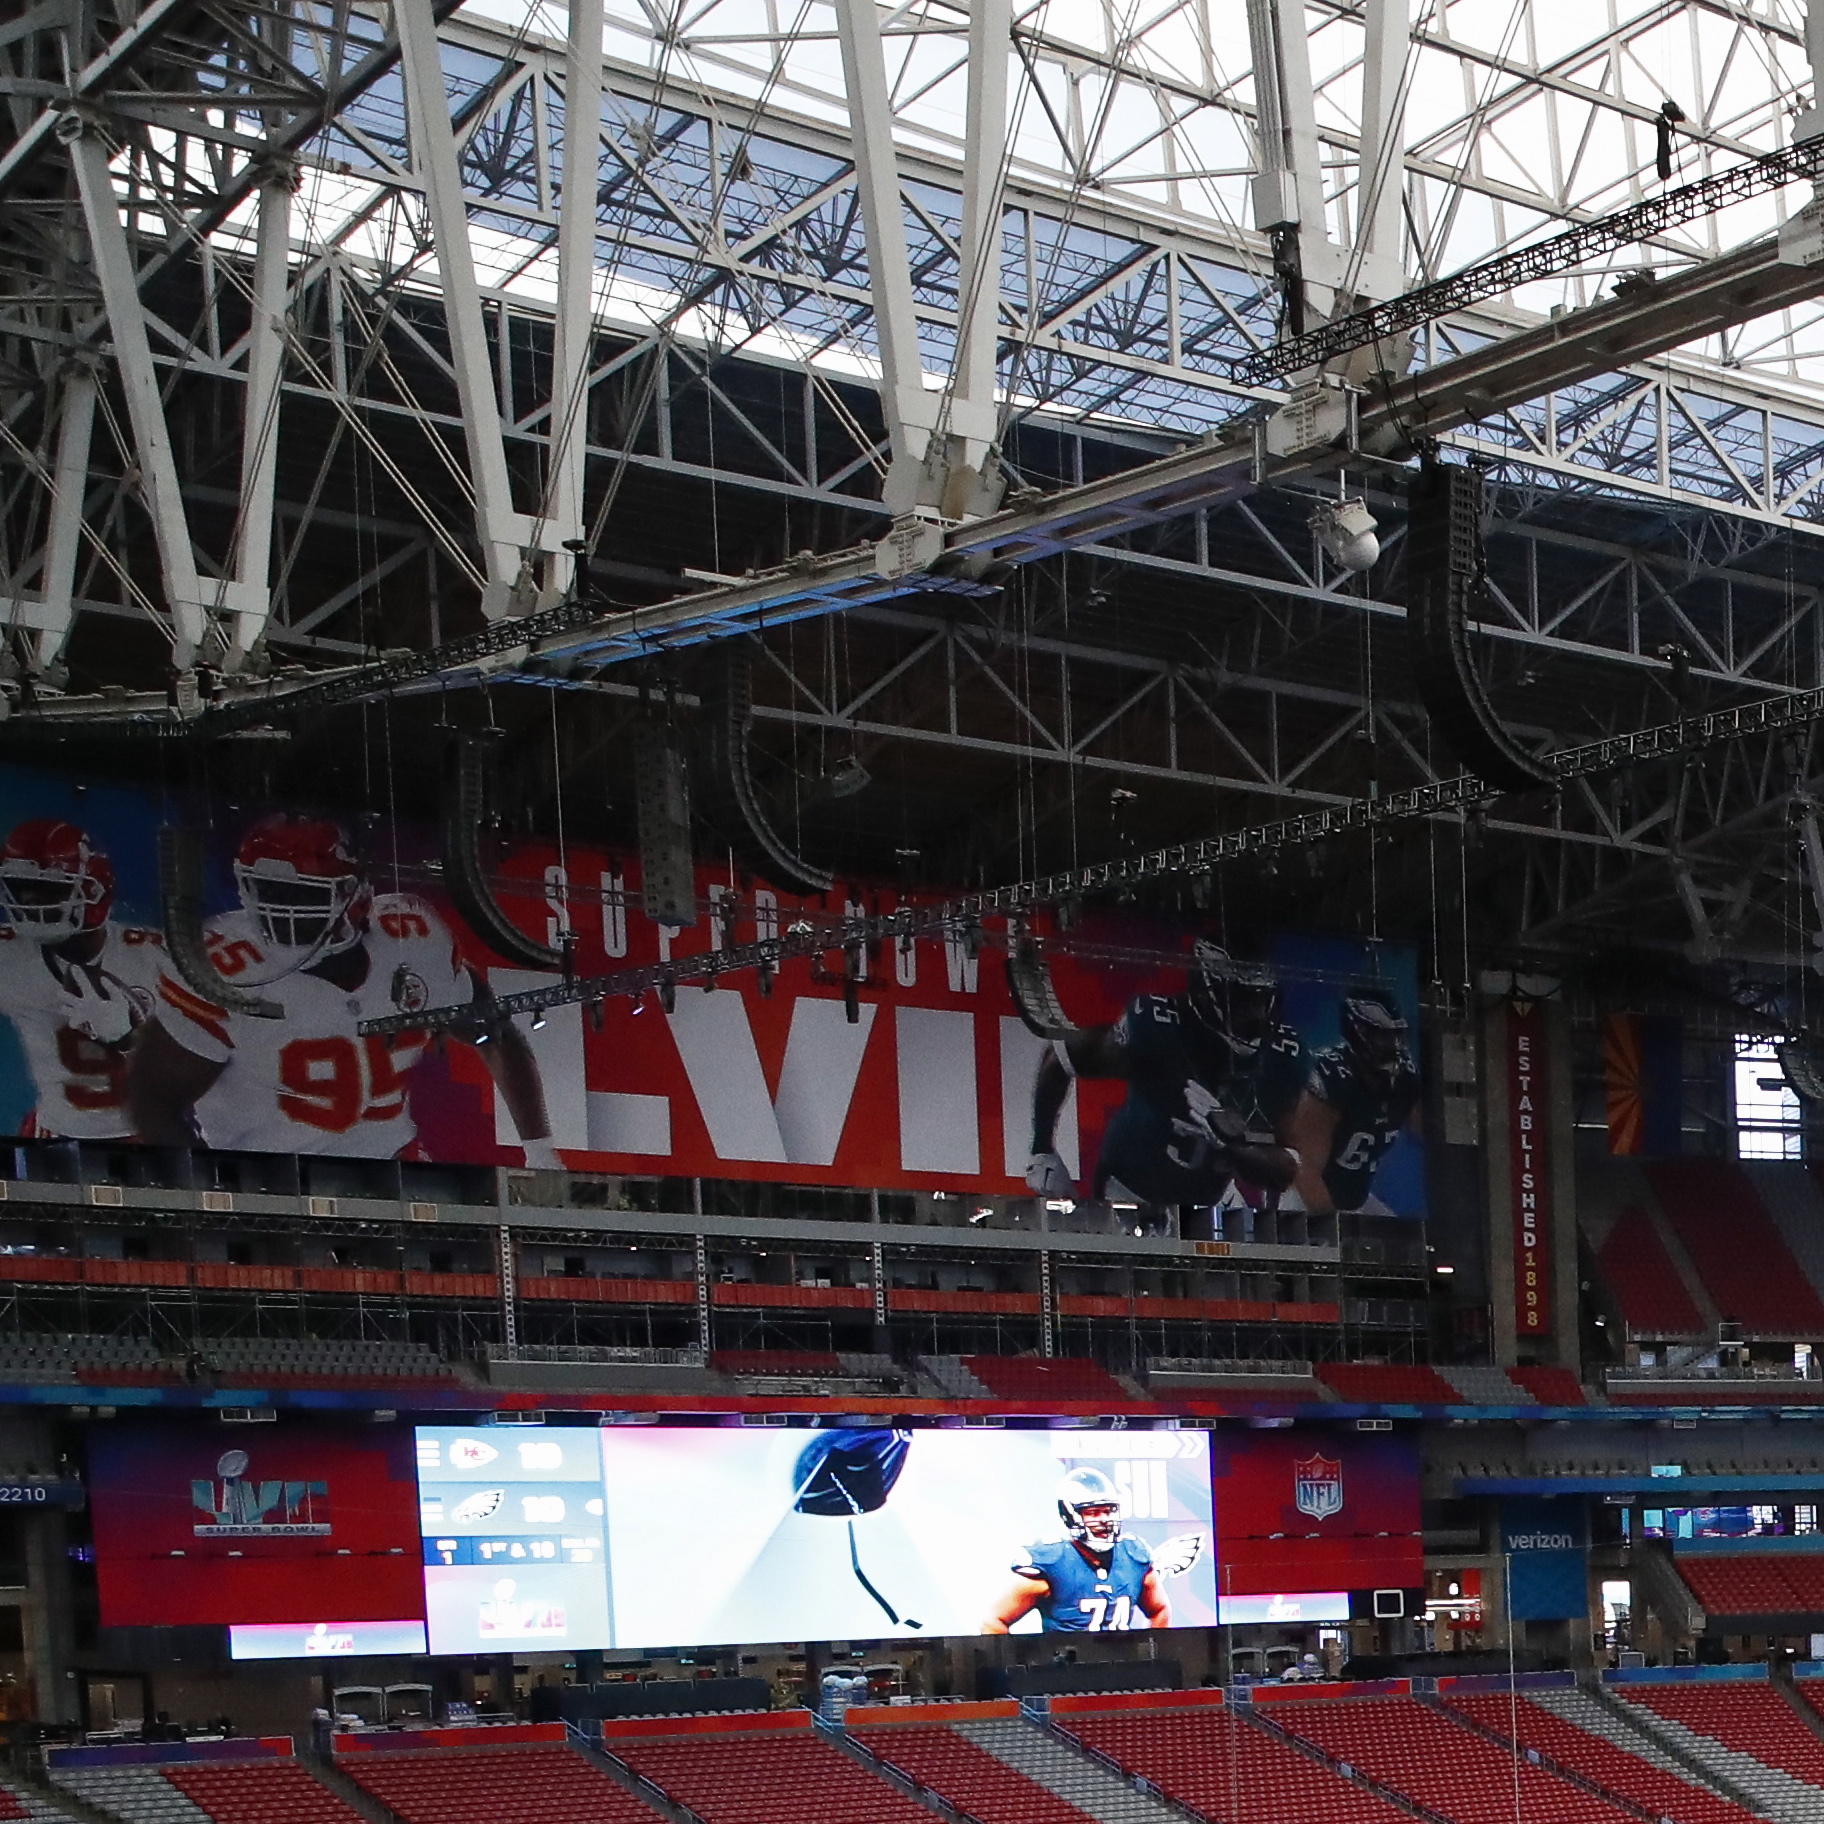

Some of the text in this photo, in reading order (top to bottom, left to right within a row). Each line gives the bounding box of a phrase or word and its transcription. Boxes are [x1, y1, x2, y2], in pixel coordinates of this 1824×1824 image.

[278, 1031, 428, 1134] 95
[488, 967, 1080, 1178] LVII
[1518, 1036, 1537, 1247] ESTABLISHED
[1524, 1251, 1538, 1327] 1898
[1301, 1482, 1337, 1508] NFL
[1508, 1531, 1573, 1549] verizon
